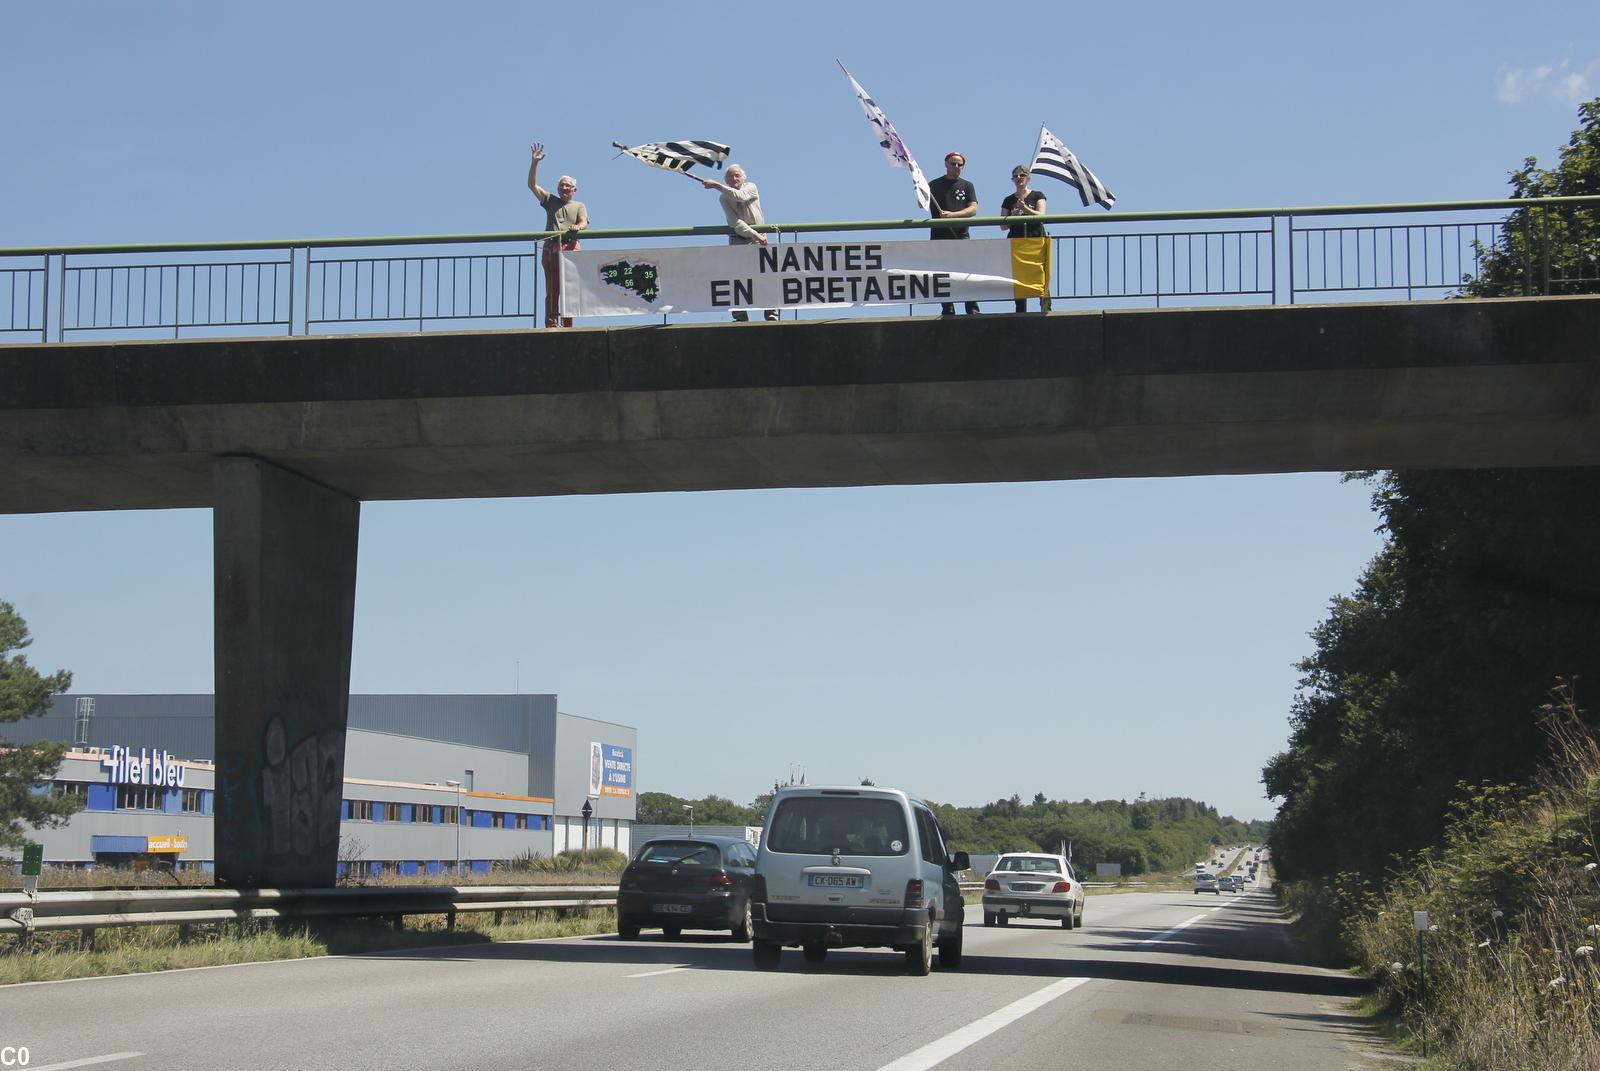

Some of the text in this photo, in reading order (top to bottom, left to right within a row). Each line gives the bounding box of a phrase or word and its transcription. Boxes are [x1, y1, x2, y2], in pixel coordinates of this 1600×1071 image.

[759, 245, 883, 273] NANTES
[608, 267, 654, 279] 29 22 35
[624, 279, 634, 287] 56
[645, 288, 654, 296] 44
[711, 273, 951, 307] EN BRETAGNE
[103, 744, 186, 787] filet bleu
[604, 759, 616, 769] VENTE
